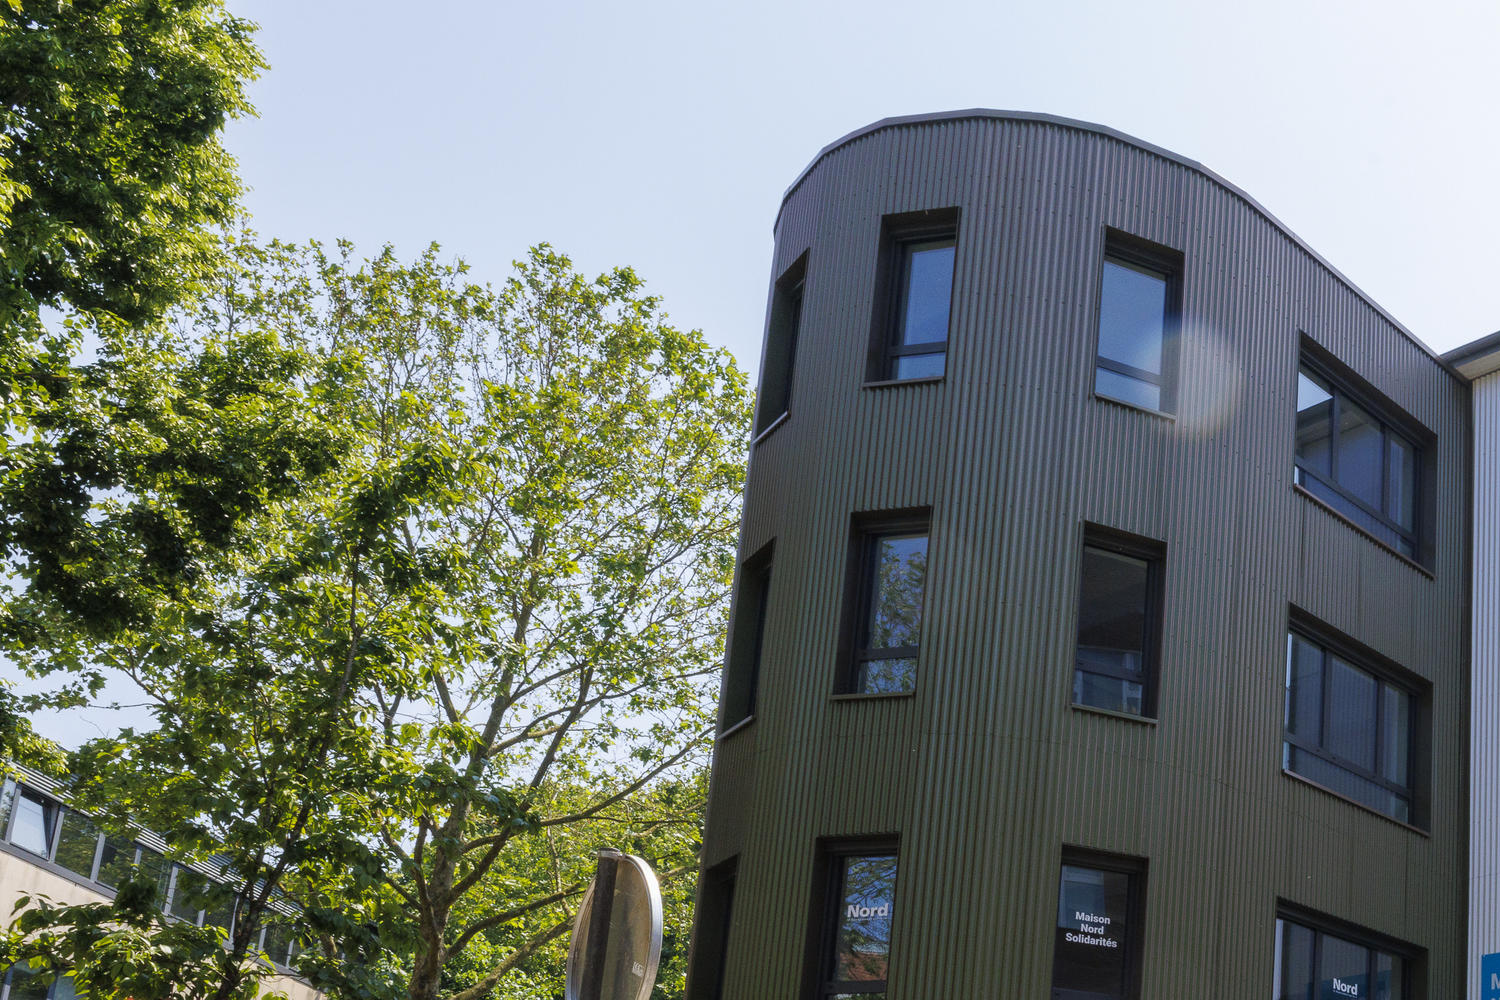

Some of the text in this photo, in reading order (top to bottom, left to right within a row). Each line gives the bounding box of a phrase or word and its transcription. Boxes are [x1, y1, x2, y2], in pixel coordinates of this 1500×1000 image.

[848, 903, 889, 917] Nord
[1075, 911, 1111, 924] Maison
[1080, 923, 1104, 934] Nord
[1065, 932, 1117, 948] Solidarités
[1333, 978, 1358, 995] Nord
